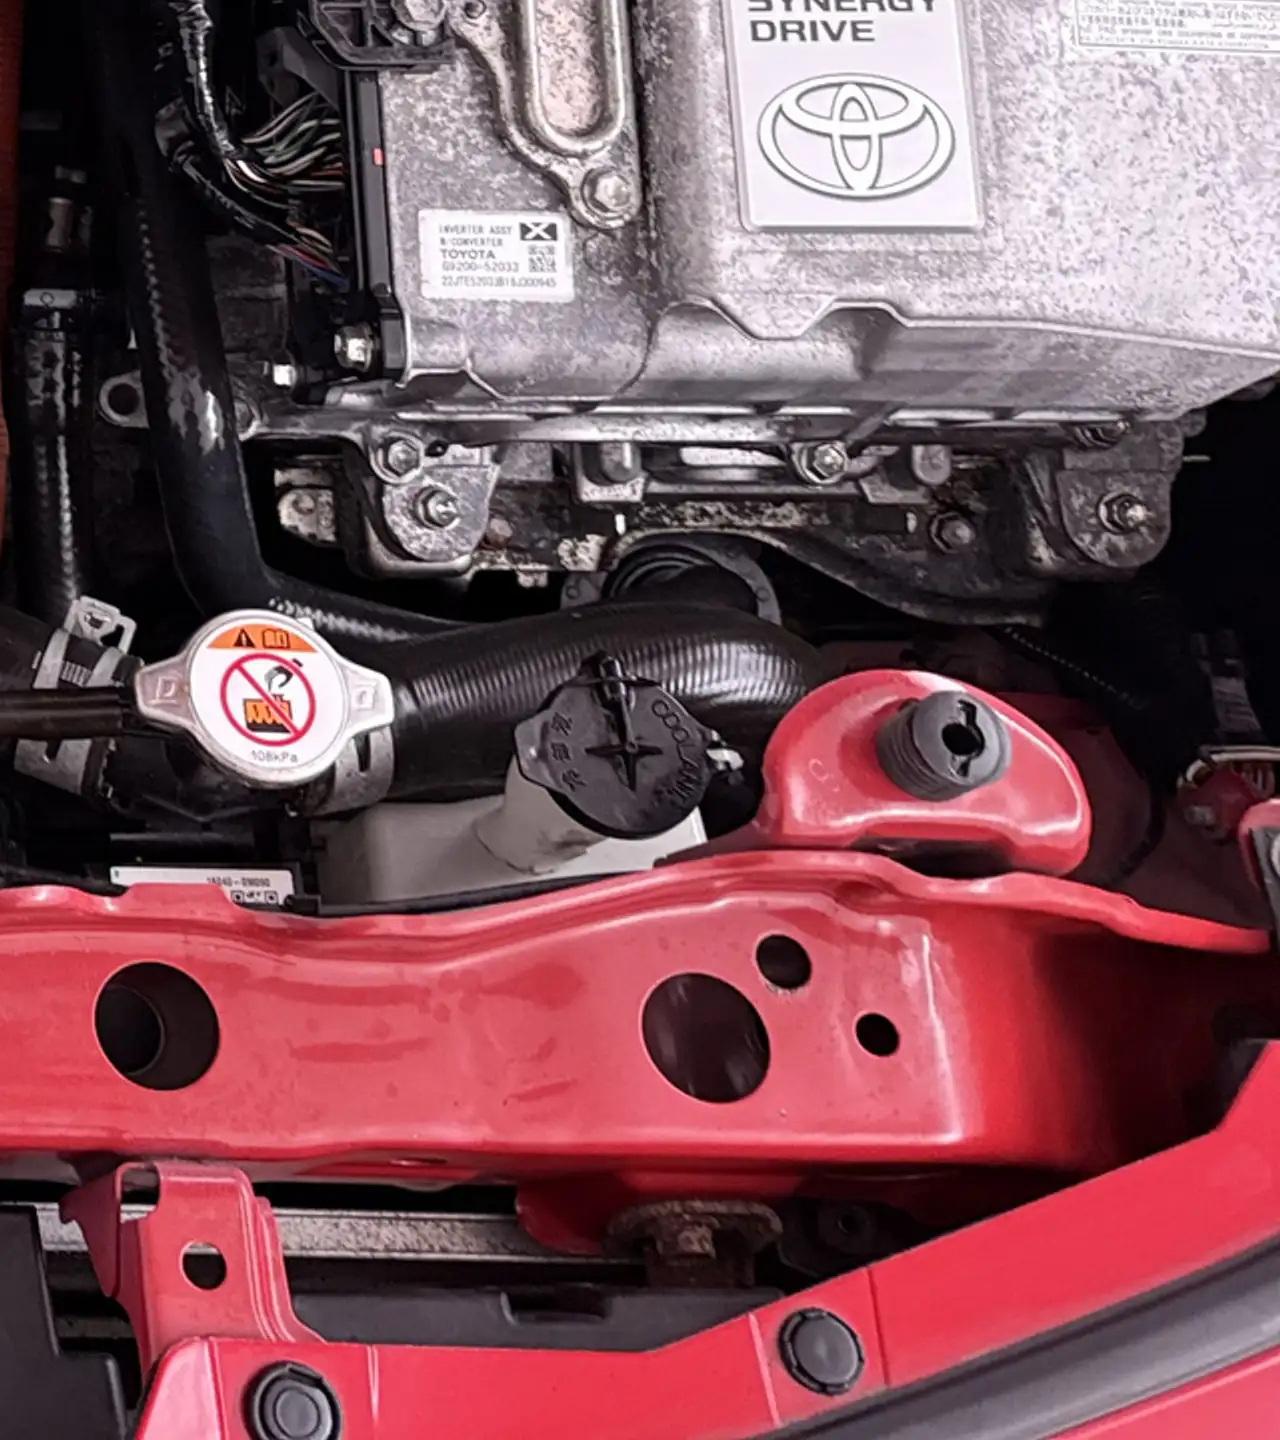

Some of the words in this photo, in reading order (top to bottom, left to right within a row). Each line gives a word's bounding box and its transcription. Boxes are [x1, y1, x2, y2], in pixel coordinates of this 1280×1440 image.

[749, 19, 877, 43] DRIVE
[438, 223, 485, 235] INVERTER
[489, 225, 513, 236] ASSY
[439, 248, 496, 260] TOYOTA
